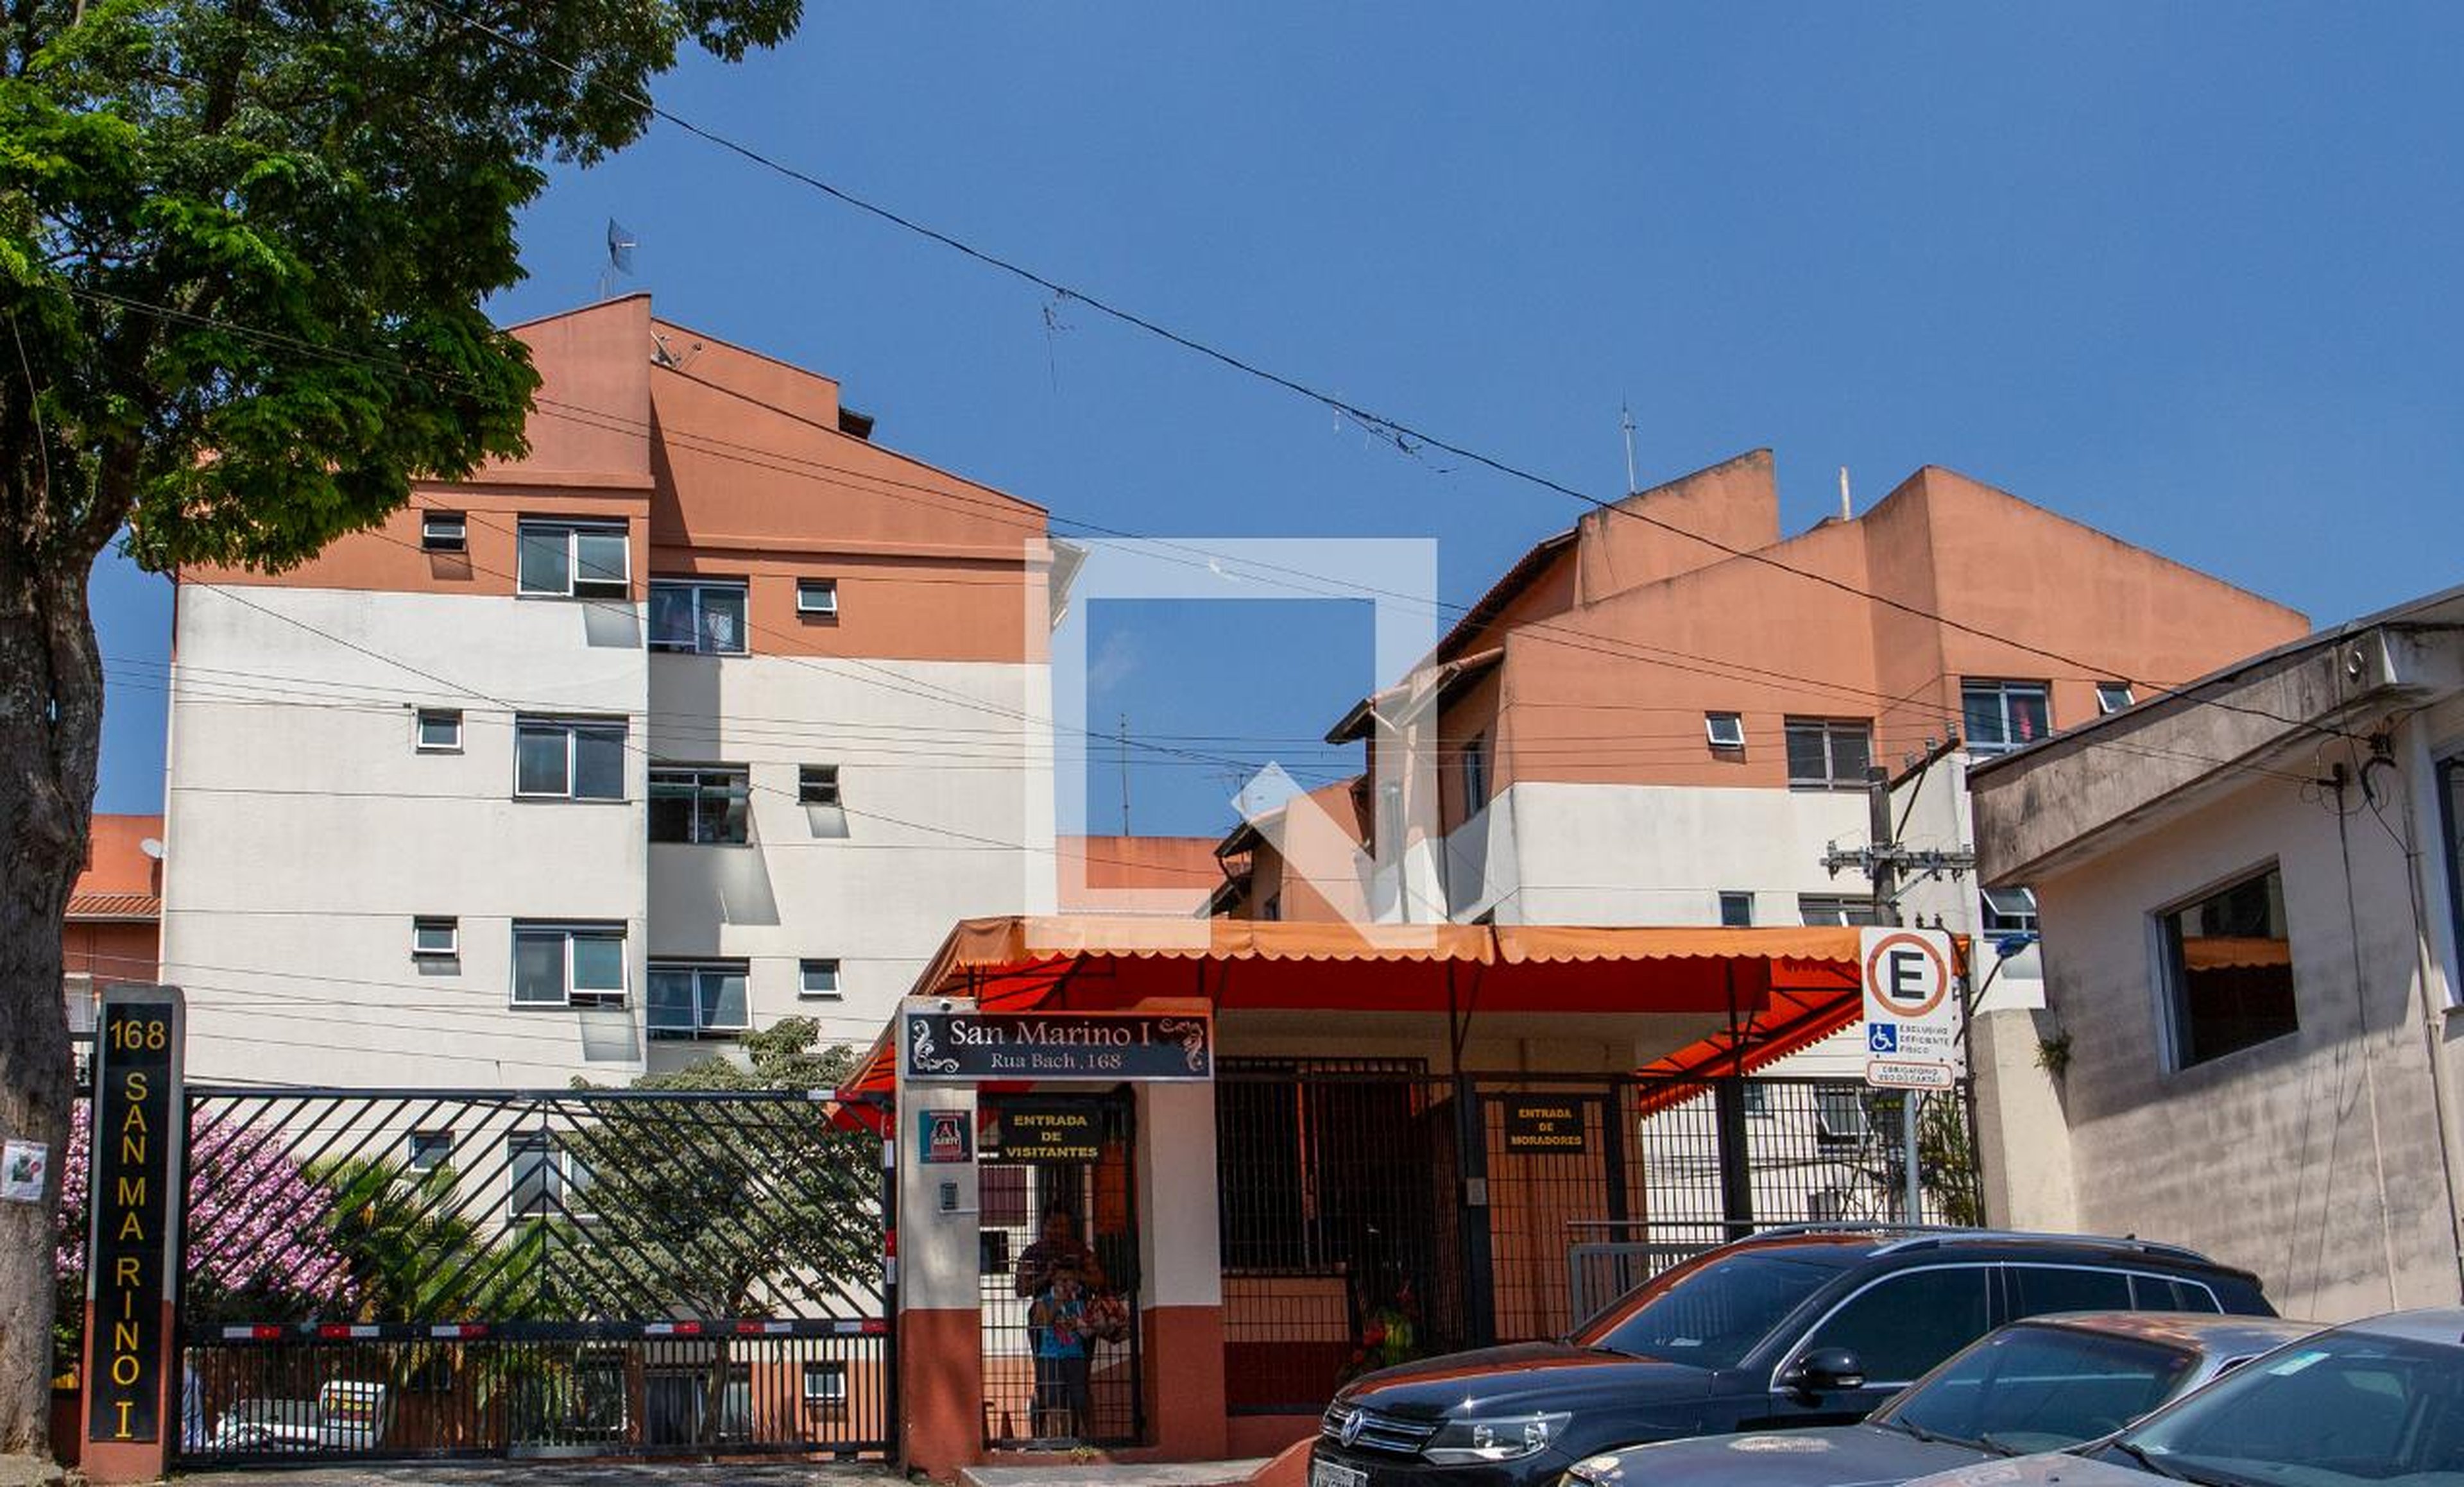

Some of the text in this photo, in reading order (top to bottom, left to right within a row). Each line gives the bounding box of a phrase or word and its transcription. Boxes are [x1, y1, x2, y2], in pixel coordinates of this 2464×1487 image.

[1890, 951, 1925, 999] E
[110, 1020, 165, 1049] 168
[950, 1021, 1150, 1046] San Marino I
[991, 1053, 1025, 1069] Rua
[1032, 1053, 1075, 1069] Bach
[123, 1072, 148, 1164] SAN
[1014, 1115, 1087, 1126] ENTRADA
[1518, 1109, 1572, 1118] ENTRADA
[1539, 1123, 1554, 1132] DE
[1041, 1132, 1063, 1142] DE
[1511, 1135, 1582, 1146] MORADORES
[1006, 1146, 1099, 1158] VISITANTES
[112, 1177, 146, 1386] MARINO
